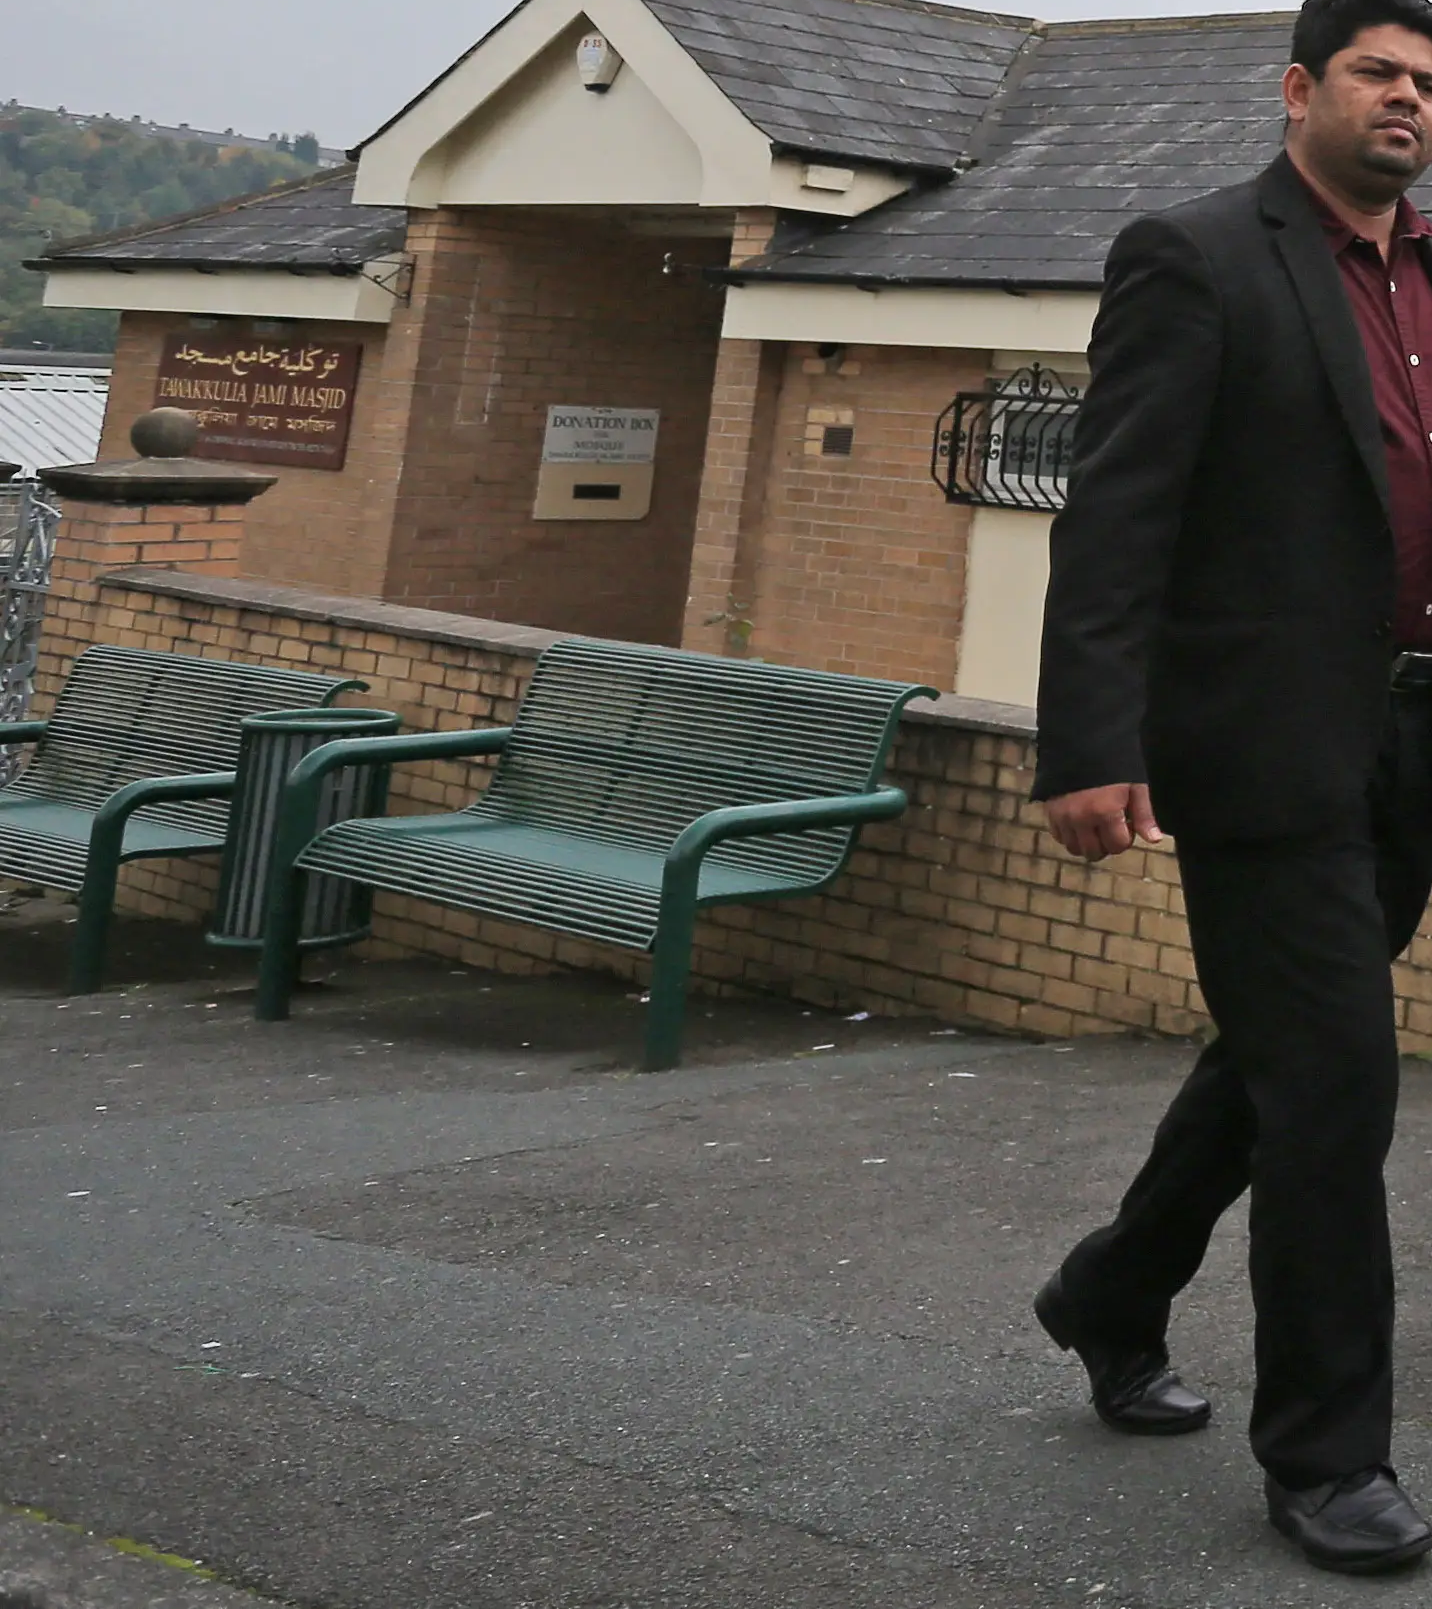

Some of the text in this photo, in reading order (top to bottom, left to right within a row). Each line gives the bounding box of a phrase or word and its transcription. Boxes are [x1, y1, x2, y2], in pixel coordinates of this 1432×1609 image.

[251, 382, 287, 408] JAMI
[289, 385, 347, 413] MASJID
[552, 414, 655, 431] DONATION BOX
